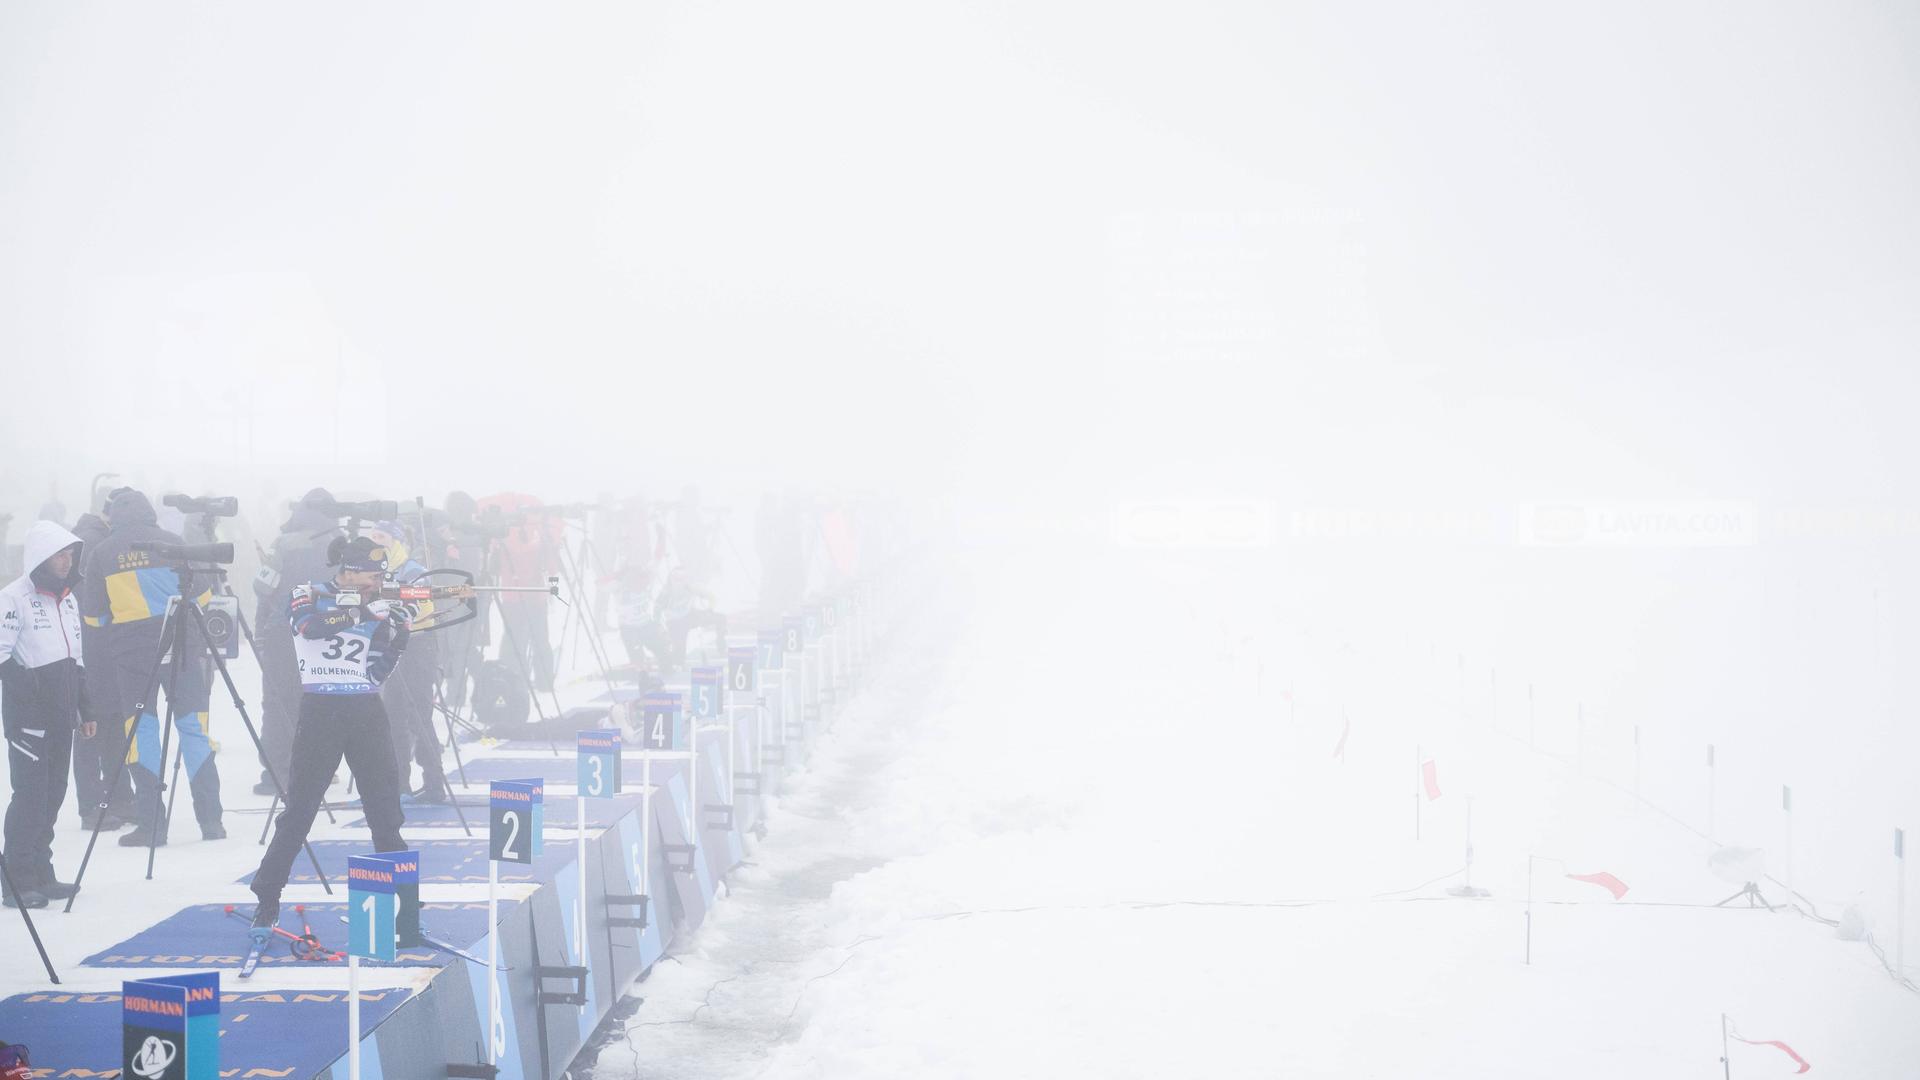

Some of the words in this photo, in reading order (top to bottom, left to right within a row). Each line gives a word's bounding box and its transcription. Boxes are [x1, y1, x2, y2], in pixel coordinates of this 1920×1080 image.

[1598, 512, 1744, 534] LAVITA.COM
[118, 551, 149, 562] SWE
[322, 634, 366, 664] 32
[787, 629, 797, 650] 8
[763, 644, 773, 668] 7
[735, 663, 747, 689] 6
[698, 686, 709, 716] 5
[652, 713, 665, 747] 4
[587, 755, 603, 796] 3
[502, 811, 519, 859] 2
[362, 895, 376, 955] 1
